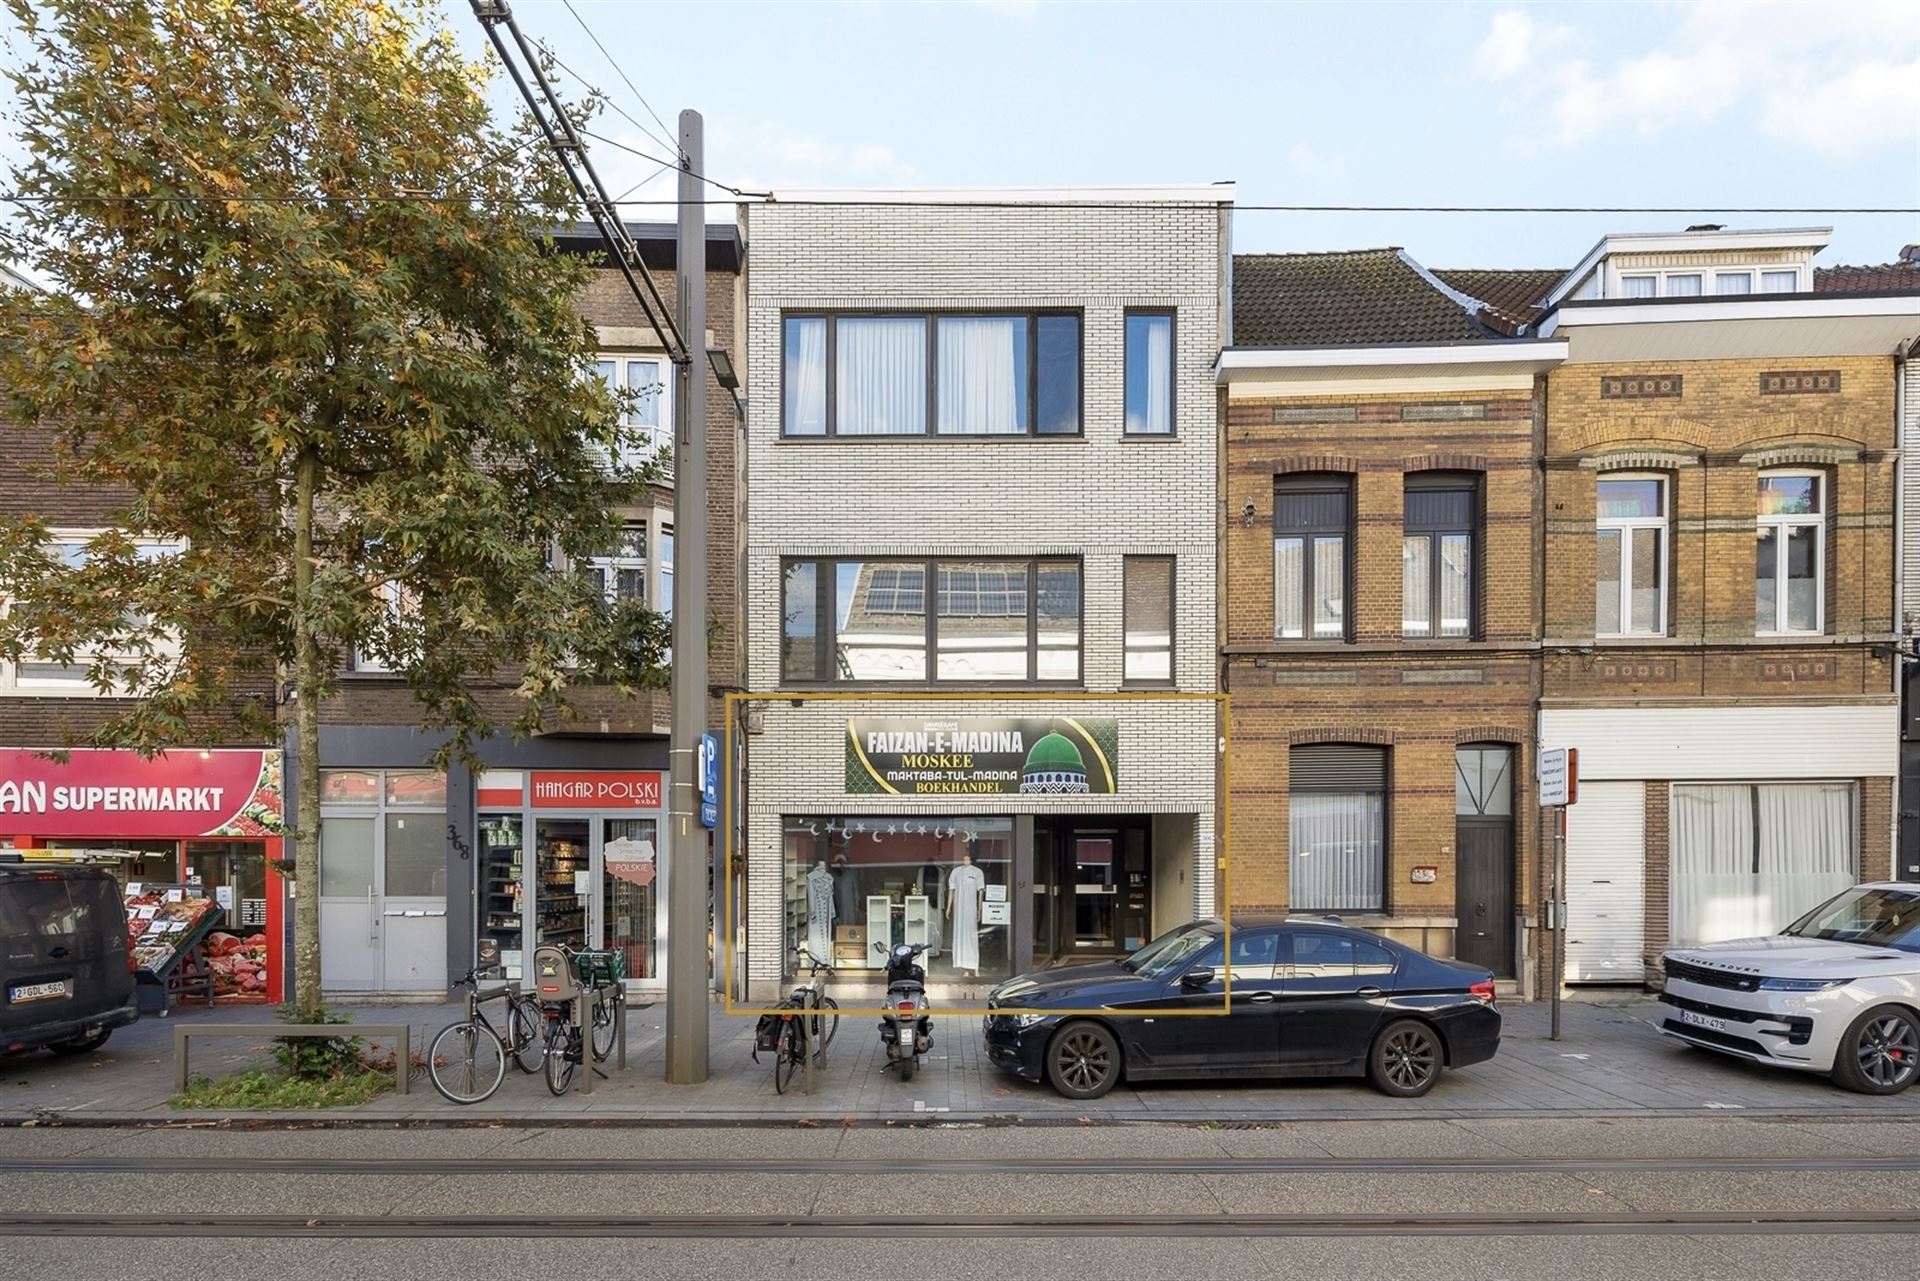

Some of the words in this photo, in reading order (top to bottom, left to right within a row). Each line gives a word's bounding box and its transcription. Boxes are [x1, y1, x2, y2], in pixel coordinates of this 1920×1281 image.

[867, 731, 1023, 753] FAIZAN-E-MADINA
[707, 740, 715, 775] P
[902, 754, 974, 768] MOSKEE
[887, 770, 1018, 781] MAKTABA-TUL-MADINA
[536, 782, 594, 798] HANGAR
[598, 782, 658, 798] POLSKI
[916, 782, 1003, 793] BOEKHANDEL
[53, 786, 223, 811] SUPERMARKT
[446, 824, 470, 860] 368
[615, 863, 649, 872] POLSKIE
